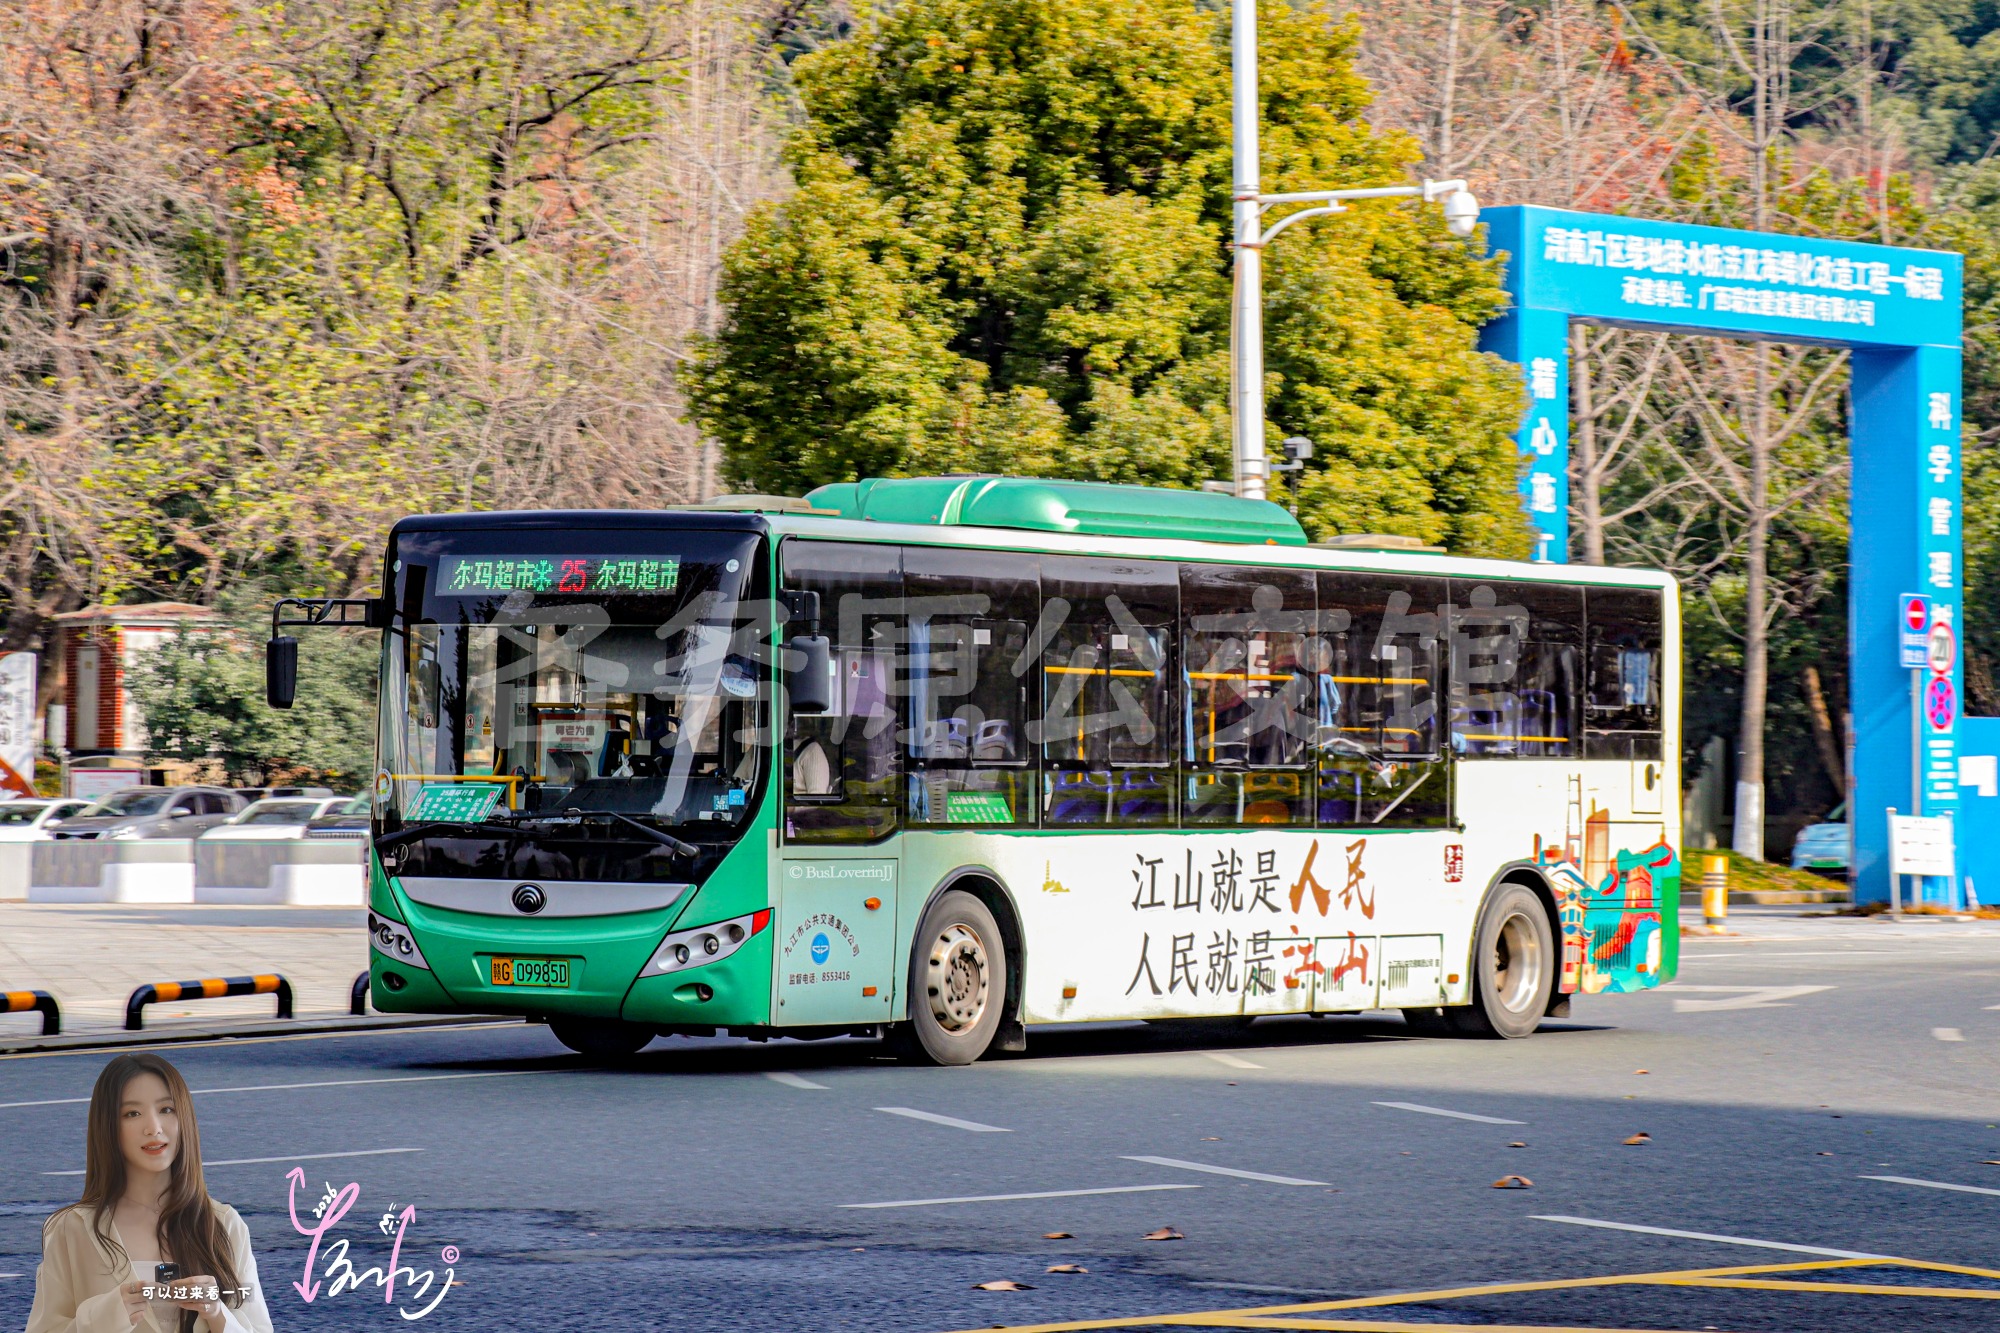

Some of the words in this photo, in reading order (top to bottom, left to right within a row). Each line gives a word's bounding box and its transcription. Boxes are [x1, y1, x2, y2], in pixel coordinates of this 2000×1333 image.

[449, 560, 534, 591] 尔玛超市
[559, 560, 587, 592] 25
[592, 560, 678, 591] 尔玛超市
[1131, 838, 1375, 920] 江山就是人民
[784, 913, 860, 957] 九江市公共交通集团公司
[1125, 926, 1370, 998] 人民就是江山
